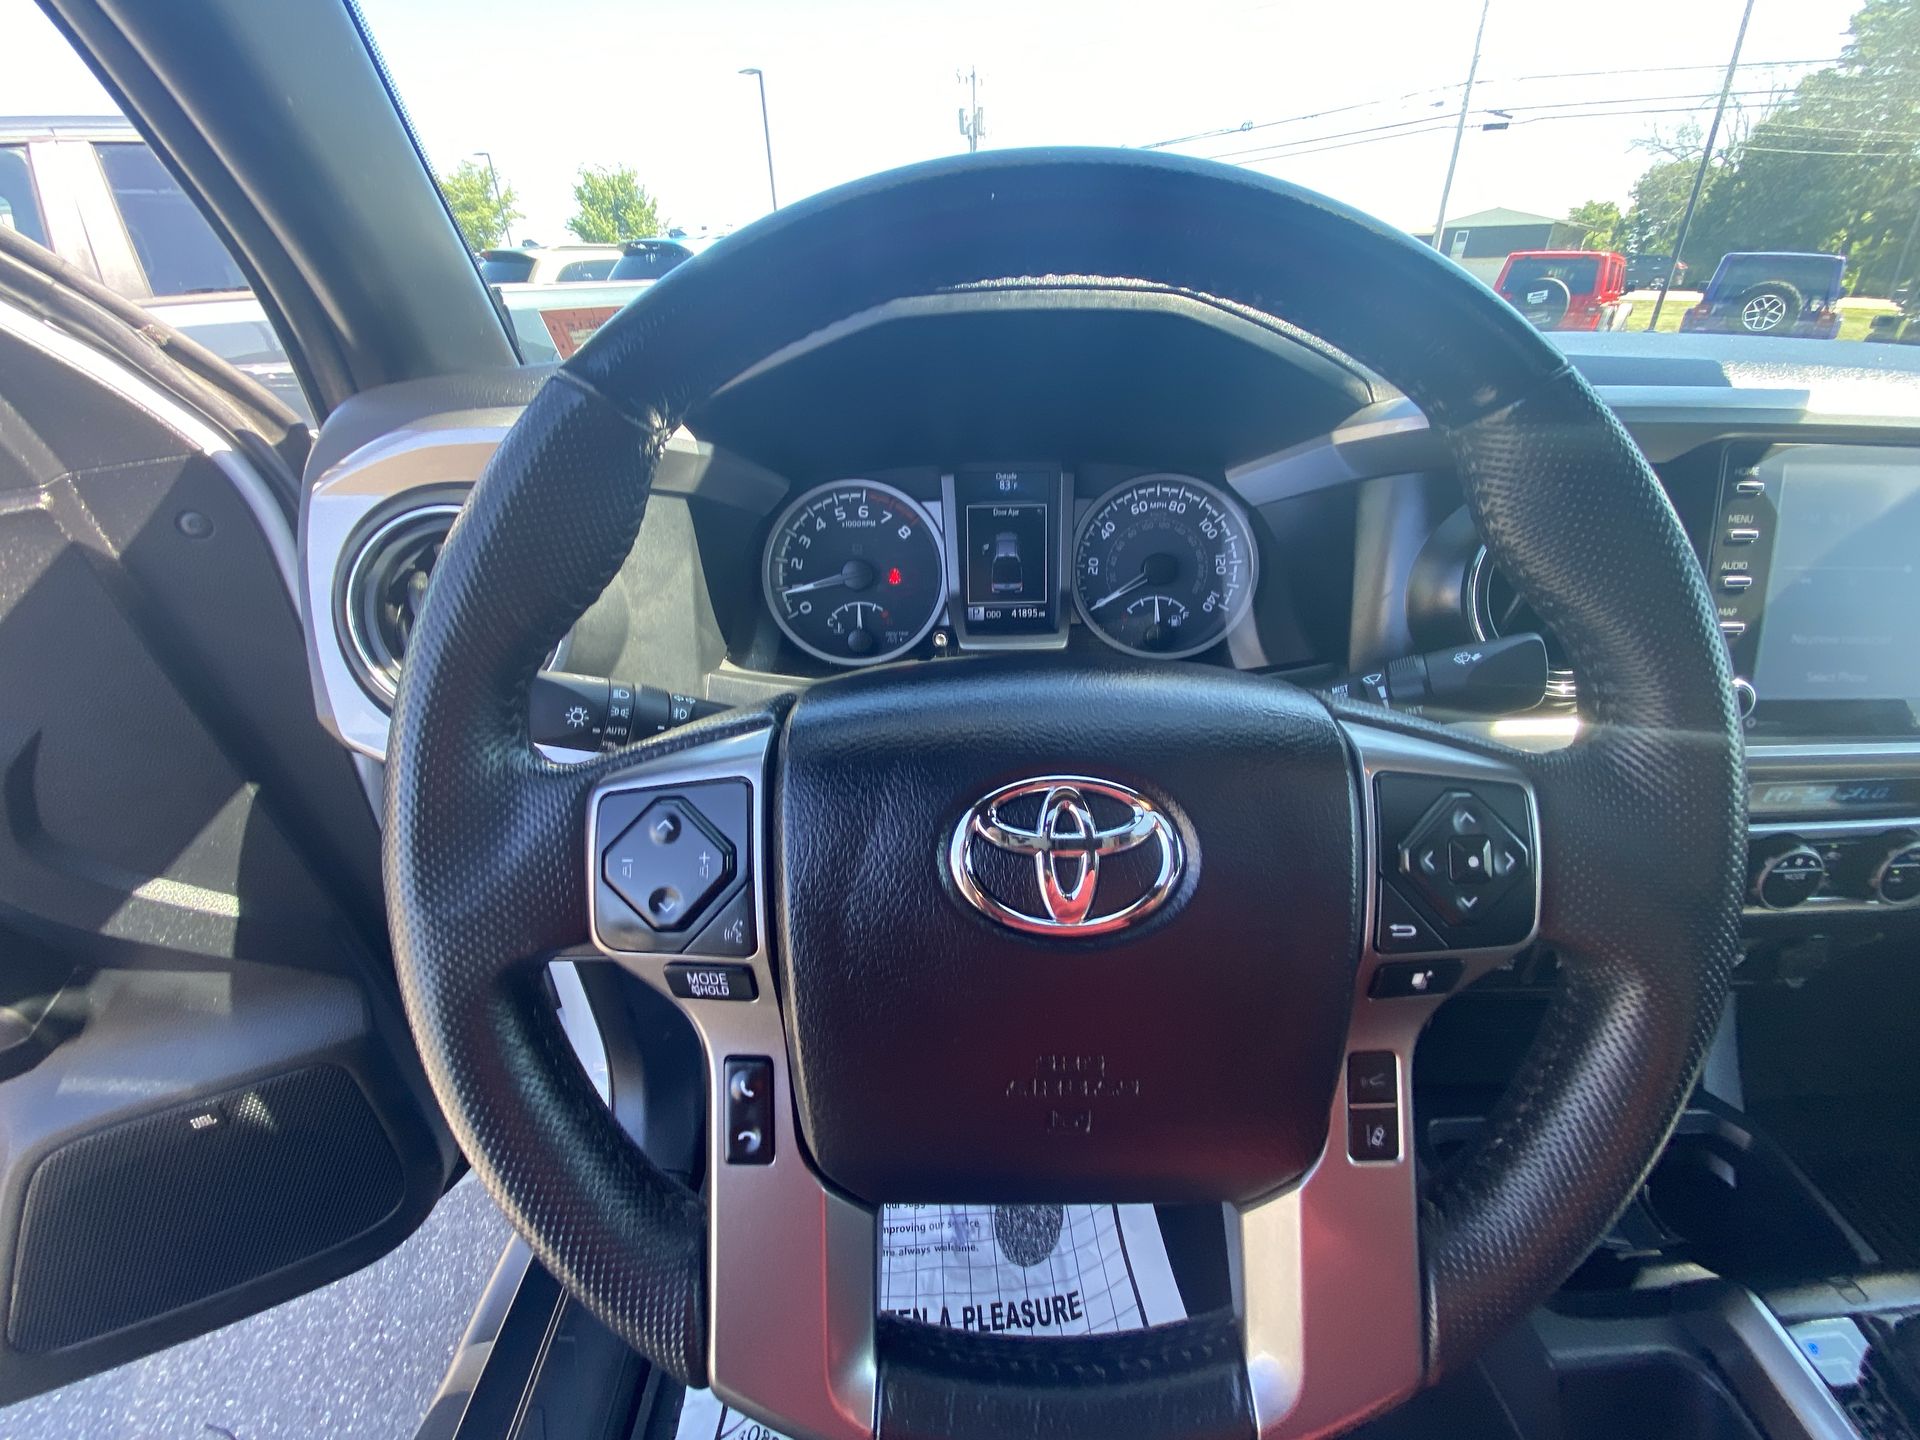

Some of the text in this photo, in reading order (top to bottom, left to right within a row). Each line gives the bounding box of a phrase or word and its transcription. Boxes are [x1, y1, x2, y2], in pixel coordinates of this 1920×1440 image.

[834, 507, 846, 521] 5
[858, 505, 869, 518] 6
[1131, 500, 1148, 515] 60
[1150, 502, 1167, 510] MPH
[1168, 500, 1186, 514] 80
[816, 516, 826, 531] 4
[880, 510, 893, 524] 7
[1728, 514, 1753, 524] MENU
[897, 525, 911, 539] 8
[1100, 521, 1115, 540] 40
[1199, 517, 1218, 540] 100
[798, 535, 811, 549] 3
[790, 557, 803, 570] 2
[1087, 557, 1099, 576] 20
[1215, 553, 1227, 576] 120
[1721, 561, 1748, 570] AUDIO
[799, 601, 812, 614] 0
[1202, 590, 1220, 613] 140
[986, 610, 1001, 619] ODO
[1011, 608, 1038, 618] 41895
[1718, 608, 1737, 617] MAP
[605, 727, 627, 736] AUTO
[687, 973, 729, 986] MODE
[700, 985, 730, 996] HOLD
[898, 1243, 930, 1256] always
[962, 1290, 1083, 1332] PLEASURE
